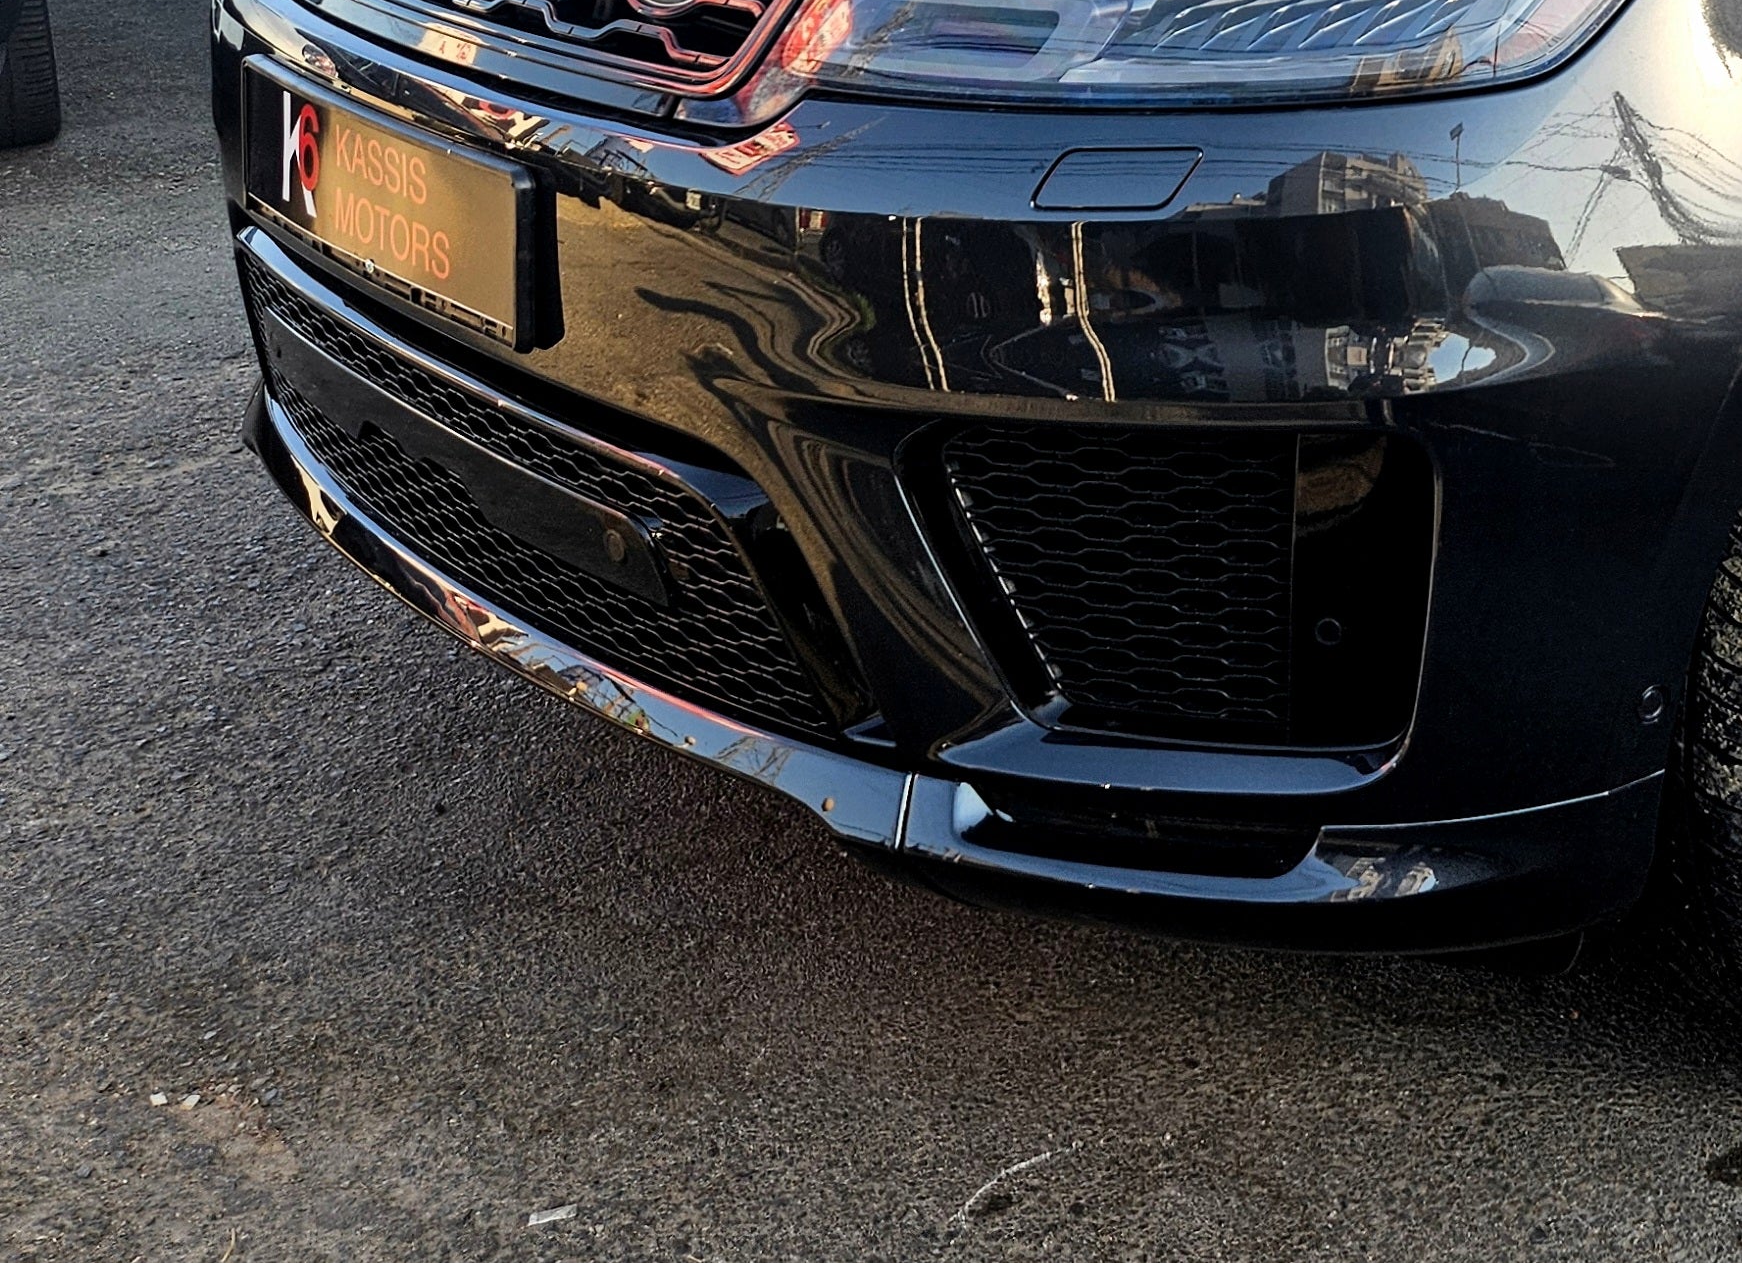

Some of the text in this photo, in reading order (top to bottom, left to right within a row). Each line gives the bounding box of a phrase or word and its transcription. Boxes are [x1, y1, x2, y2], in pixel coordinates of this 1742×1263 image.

[281, 90, 320, 218] K6
[334, 124, 428, 205] KASSIS
[334, 194, 451, 280] MOTORS
